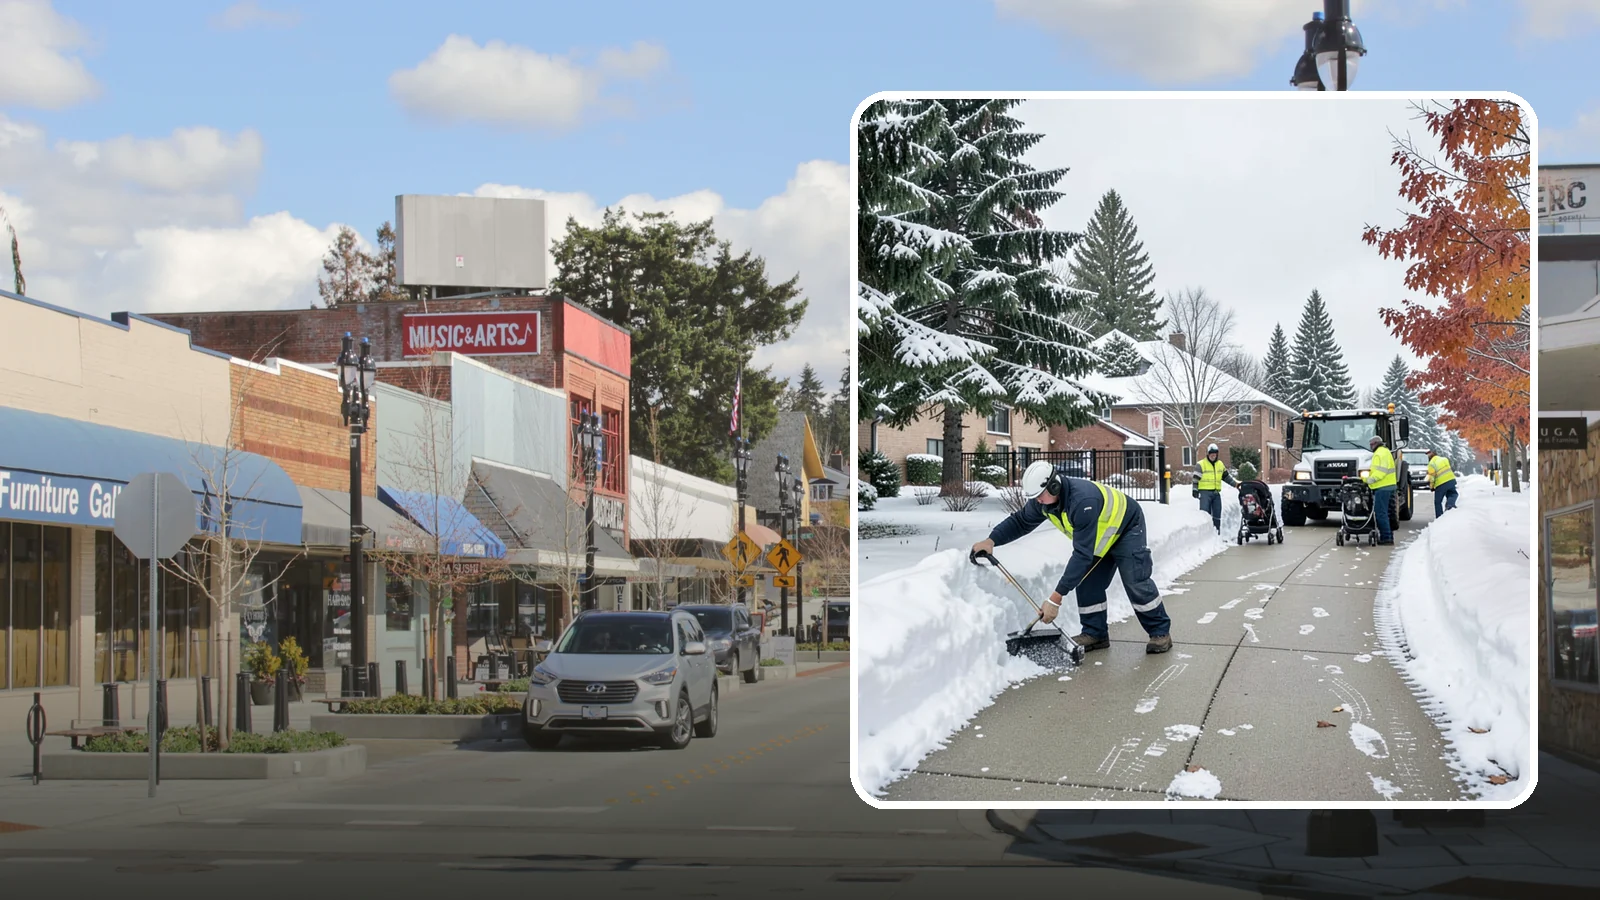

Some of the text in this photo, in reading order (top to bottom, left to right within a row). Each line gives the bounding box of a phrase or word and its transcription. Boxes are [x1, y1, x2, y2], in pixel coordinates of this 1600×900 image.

[1538, 181, 1587, 213] ERC
[409, 323, 519, 349] MUSIC&ARTS
[1540, 427, 1577, 437] UGA
[0, 471, 122, 519] Furniture Gal
[453, 563, 479, 574] SUSHI
